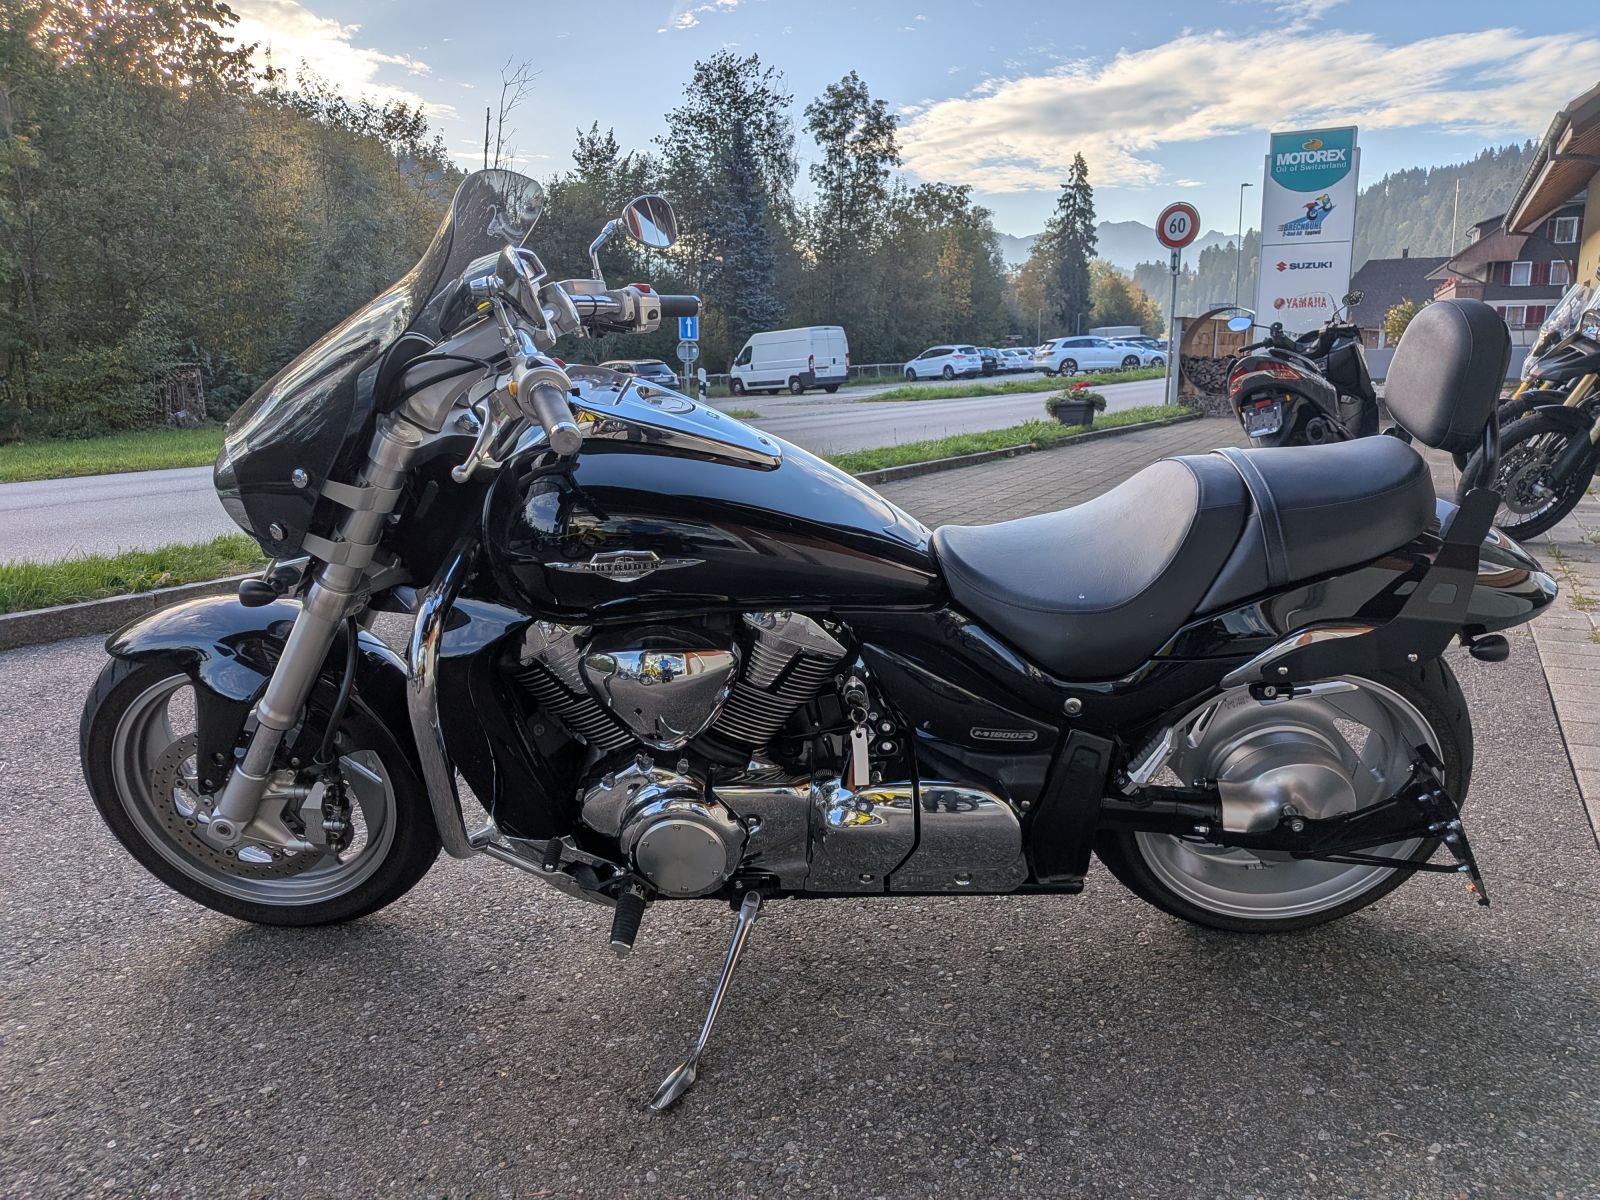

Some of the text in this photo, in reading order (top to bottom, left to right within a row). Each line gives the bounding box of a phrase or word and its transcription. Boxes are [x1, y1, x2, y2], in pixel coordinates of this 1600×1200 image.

[1276, 149, 1346, 166] MOTOREX
[1300, 161, 1347, 171] Switzerland
[1169, 217, 1186, 234] 60
[1289, 261, 1333, 270] SUZUKI
[1286, 296, 1327, 309] YAMAHA
[591, 561, 660, 572] INTRUDER
